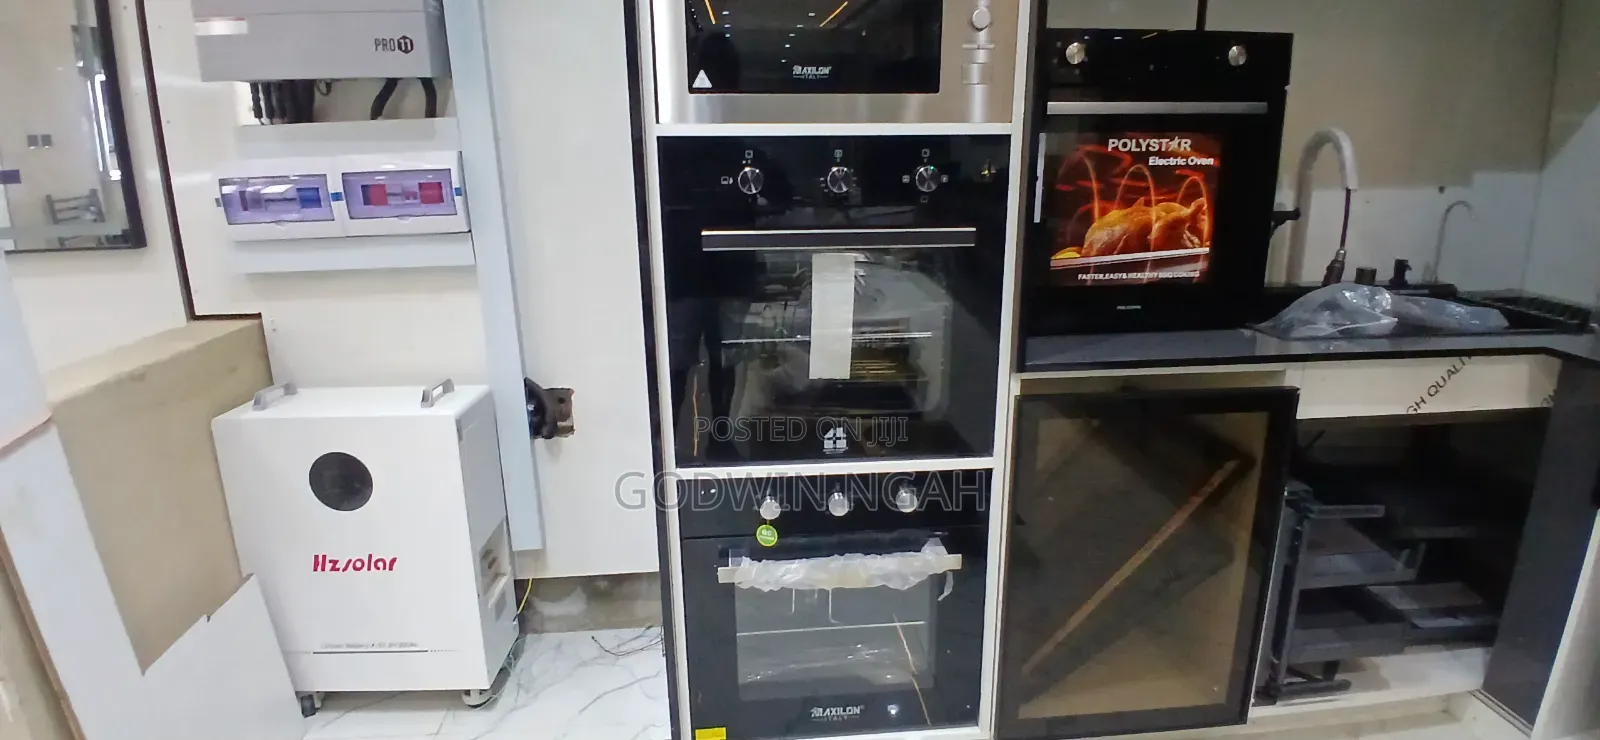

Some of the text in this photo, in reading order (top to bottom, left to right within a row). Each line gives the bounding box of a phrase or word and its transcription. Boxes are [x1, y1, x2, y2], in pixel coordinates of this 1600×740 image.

[374, 37, 396, 52] PRO
[1107, 136, 1192, 152] POLYSTAR
[1148, 156, 1214, 166] Electric Oven
[1427, 355, 1472, 397] QUALI
[811, 705, 861, 717] MAXILON
